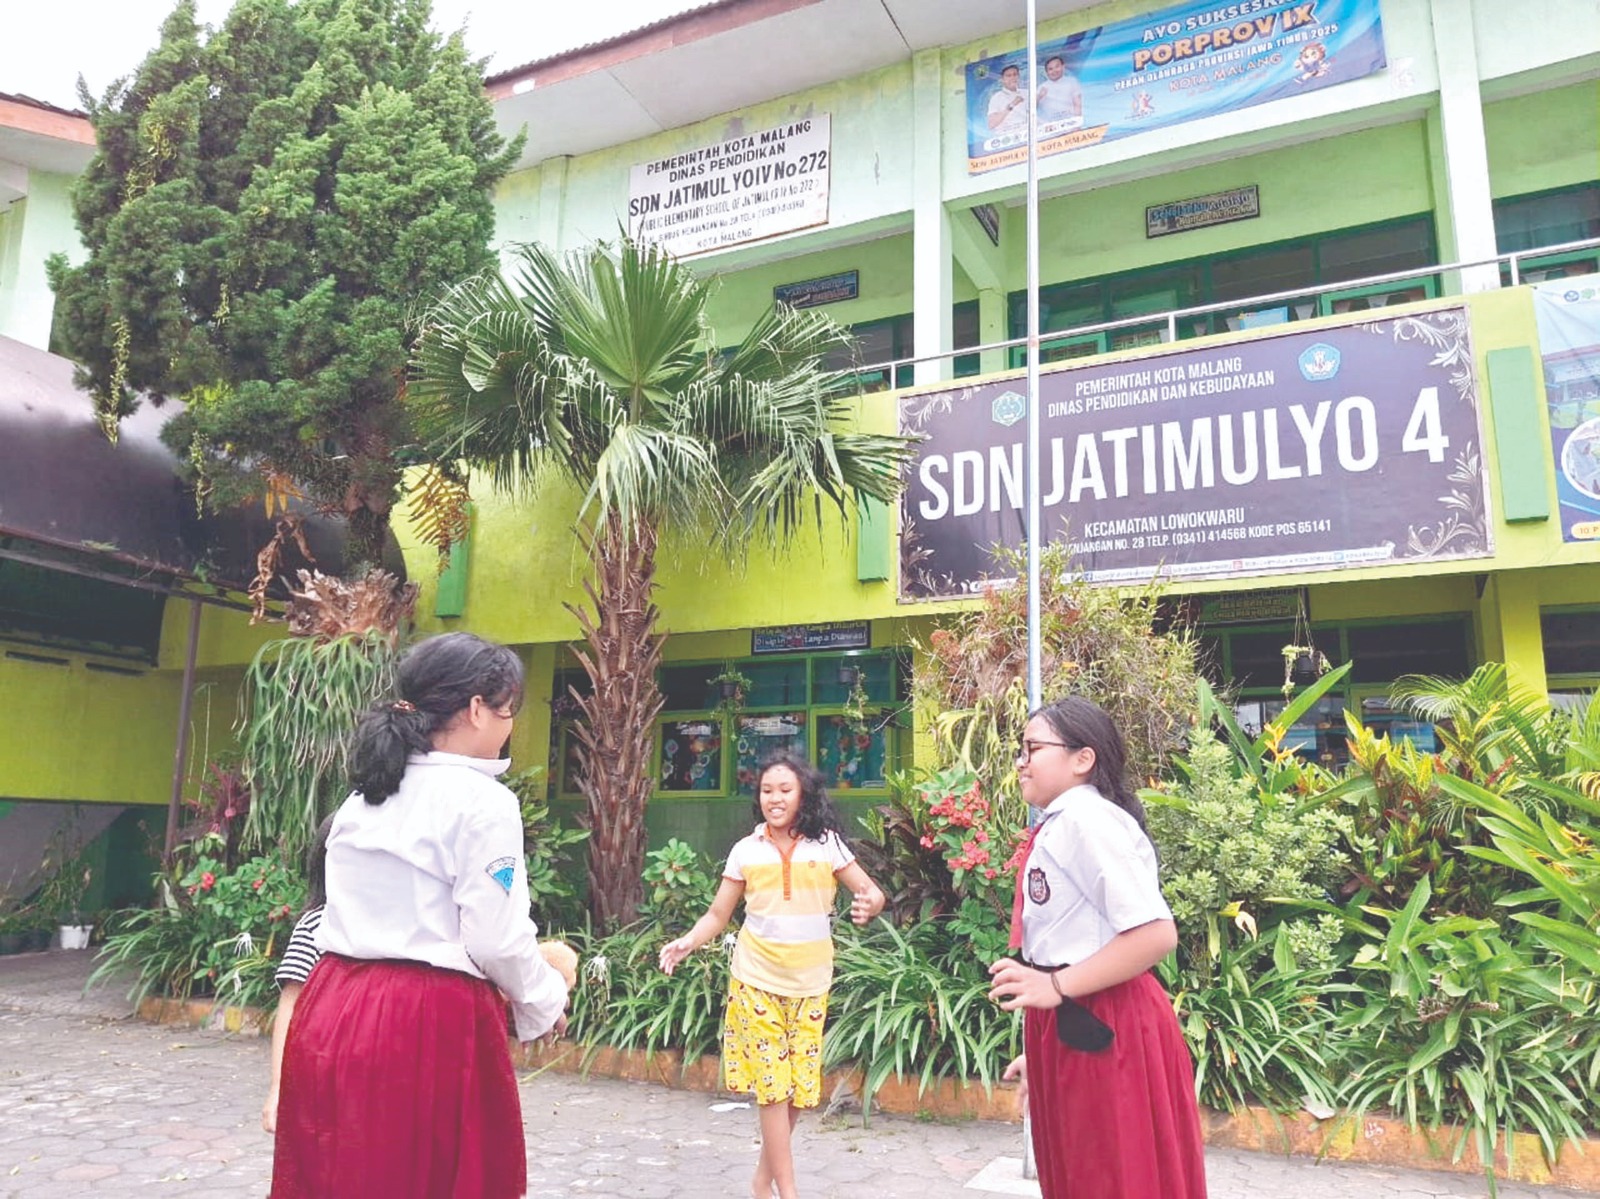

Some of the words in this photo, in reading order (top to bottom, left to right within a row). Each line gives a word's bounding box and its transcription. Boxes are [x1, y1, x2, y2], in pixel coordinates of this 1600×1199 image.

[1133, 14, 1276, 72] PORPROV
[1281, 4, 1315, 32] IX
[1143, 22, 1181, 43] AYO
[1247, 42, 1273, 56] JAWA
[1276, 32, 1308, 48] TIMUR
[1311, 24, 1338, 39] 2025
[1169, 74, 1208, 92] KOTA
[1213, 53, 1283, 80] MALANG
[646, 145, 720, 176] PEMERINTAH
[724, 136, 755, 155] KOTA
[760, 120, 811, 145] MALANG
[669, 163, 706, 183] DINAS
[710, 142, 786, 172] PENDIDIKAN
[629, 192, 661, 217] SDN
[664, 206, 704, 227] ELEMENTARY
[720, 228, 752, 243] MALANG
[1075, 371, 1151, 396] PEMERINTAH
[1153, 368, 1186, 384] KOTA
[1188, 357, 1242, 379] MALANG
[1048, 400, 1083, 418] DINAS
[1086, 388, 1158, 411] PENDIDIKAN
[1161, 384, 1187, 400] DAN
[1190, 371, 1275, 398] KEBUDAYAAN
[919, 443, 1024, 520] SDN
[1043, 396, 1379, 506] JATIMULYO
[1402, 386, 1450, 463] 4
[1084, 516, 1158, 538] KECAMATAN
[1160, 507, 1245, 530] LOWOKWARU
[1115, 539, 1130, 550] NO.
[1132, 537, 1144, 549] 28
[1147, 535, 1171, 548] TELP.
[1172, 531, 1206, 545] (0341)
[1208, 527, 1246, 542] 414568
[1248, 524, 1274, 538] KODE
[1276, 523, 1296, 536] POS
[1298, 519, 1332, 534] 65141
